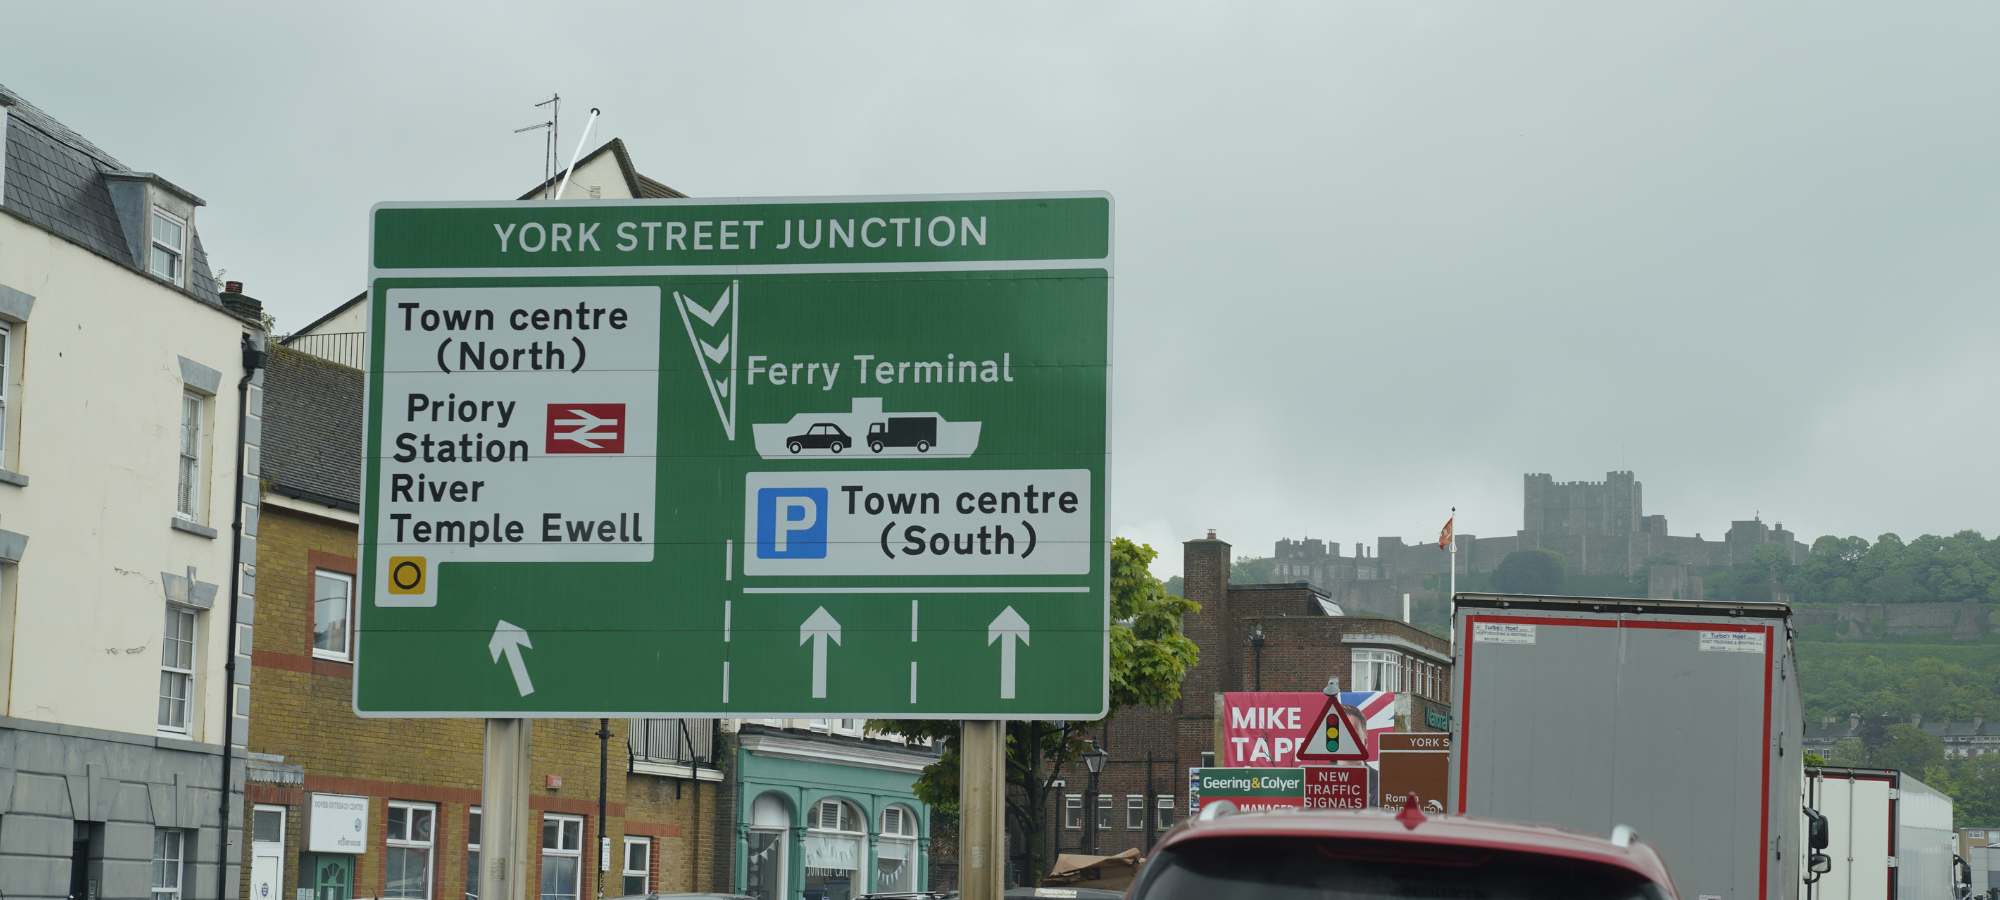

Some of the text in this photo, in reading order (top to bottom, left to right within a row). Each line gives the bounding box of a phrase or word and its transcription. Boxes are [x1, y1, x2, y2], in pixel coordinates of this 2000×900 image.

[493, 215, 987, 252] YORK STREET JUNCTION
[398, 301, 628, 332] Town centre
[437, 336, 586, 374] (North)
[747, 352, 1014, 391] Ferry Terminal
[407, 392, 516, 428] Priory
[392, 432, 529, 463] Station
[391, 473, 485, 503] River
[841, 484, 1079, 515] Town centre
[389, 512, 643, 547] Temple Ewell
[774, 496, 817, 552] P
[880, 520, 1037, 560] (South)
[1231, 706, 1302, 729] MIKE
[1409, 738, 1440, 747] YORK
[1306, 784, 1361, 795] TRAFFIC
[1318, 771, 1349, 782] NEW
[1304, 797, 1362, 809] SIGNALS
[1385, 793, 1419, 803] Romn
